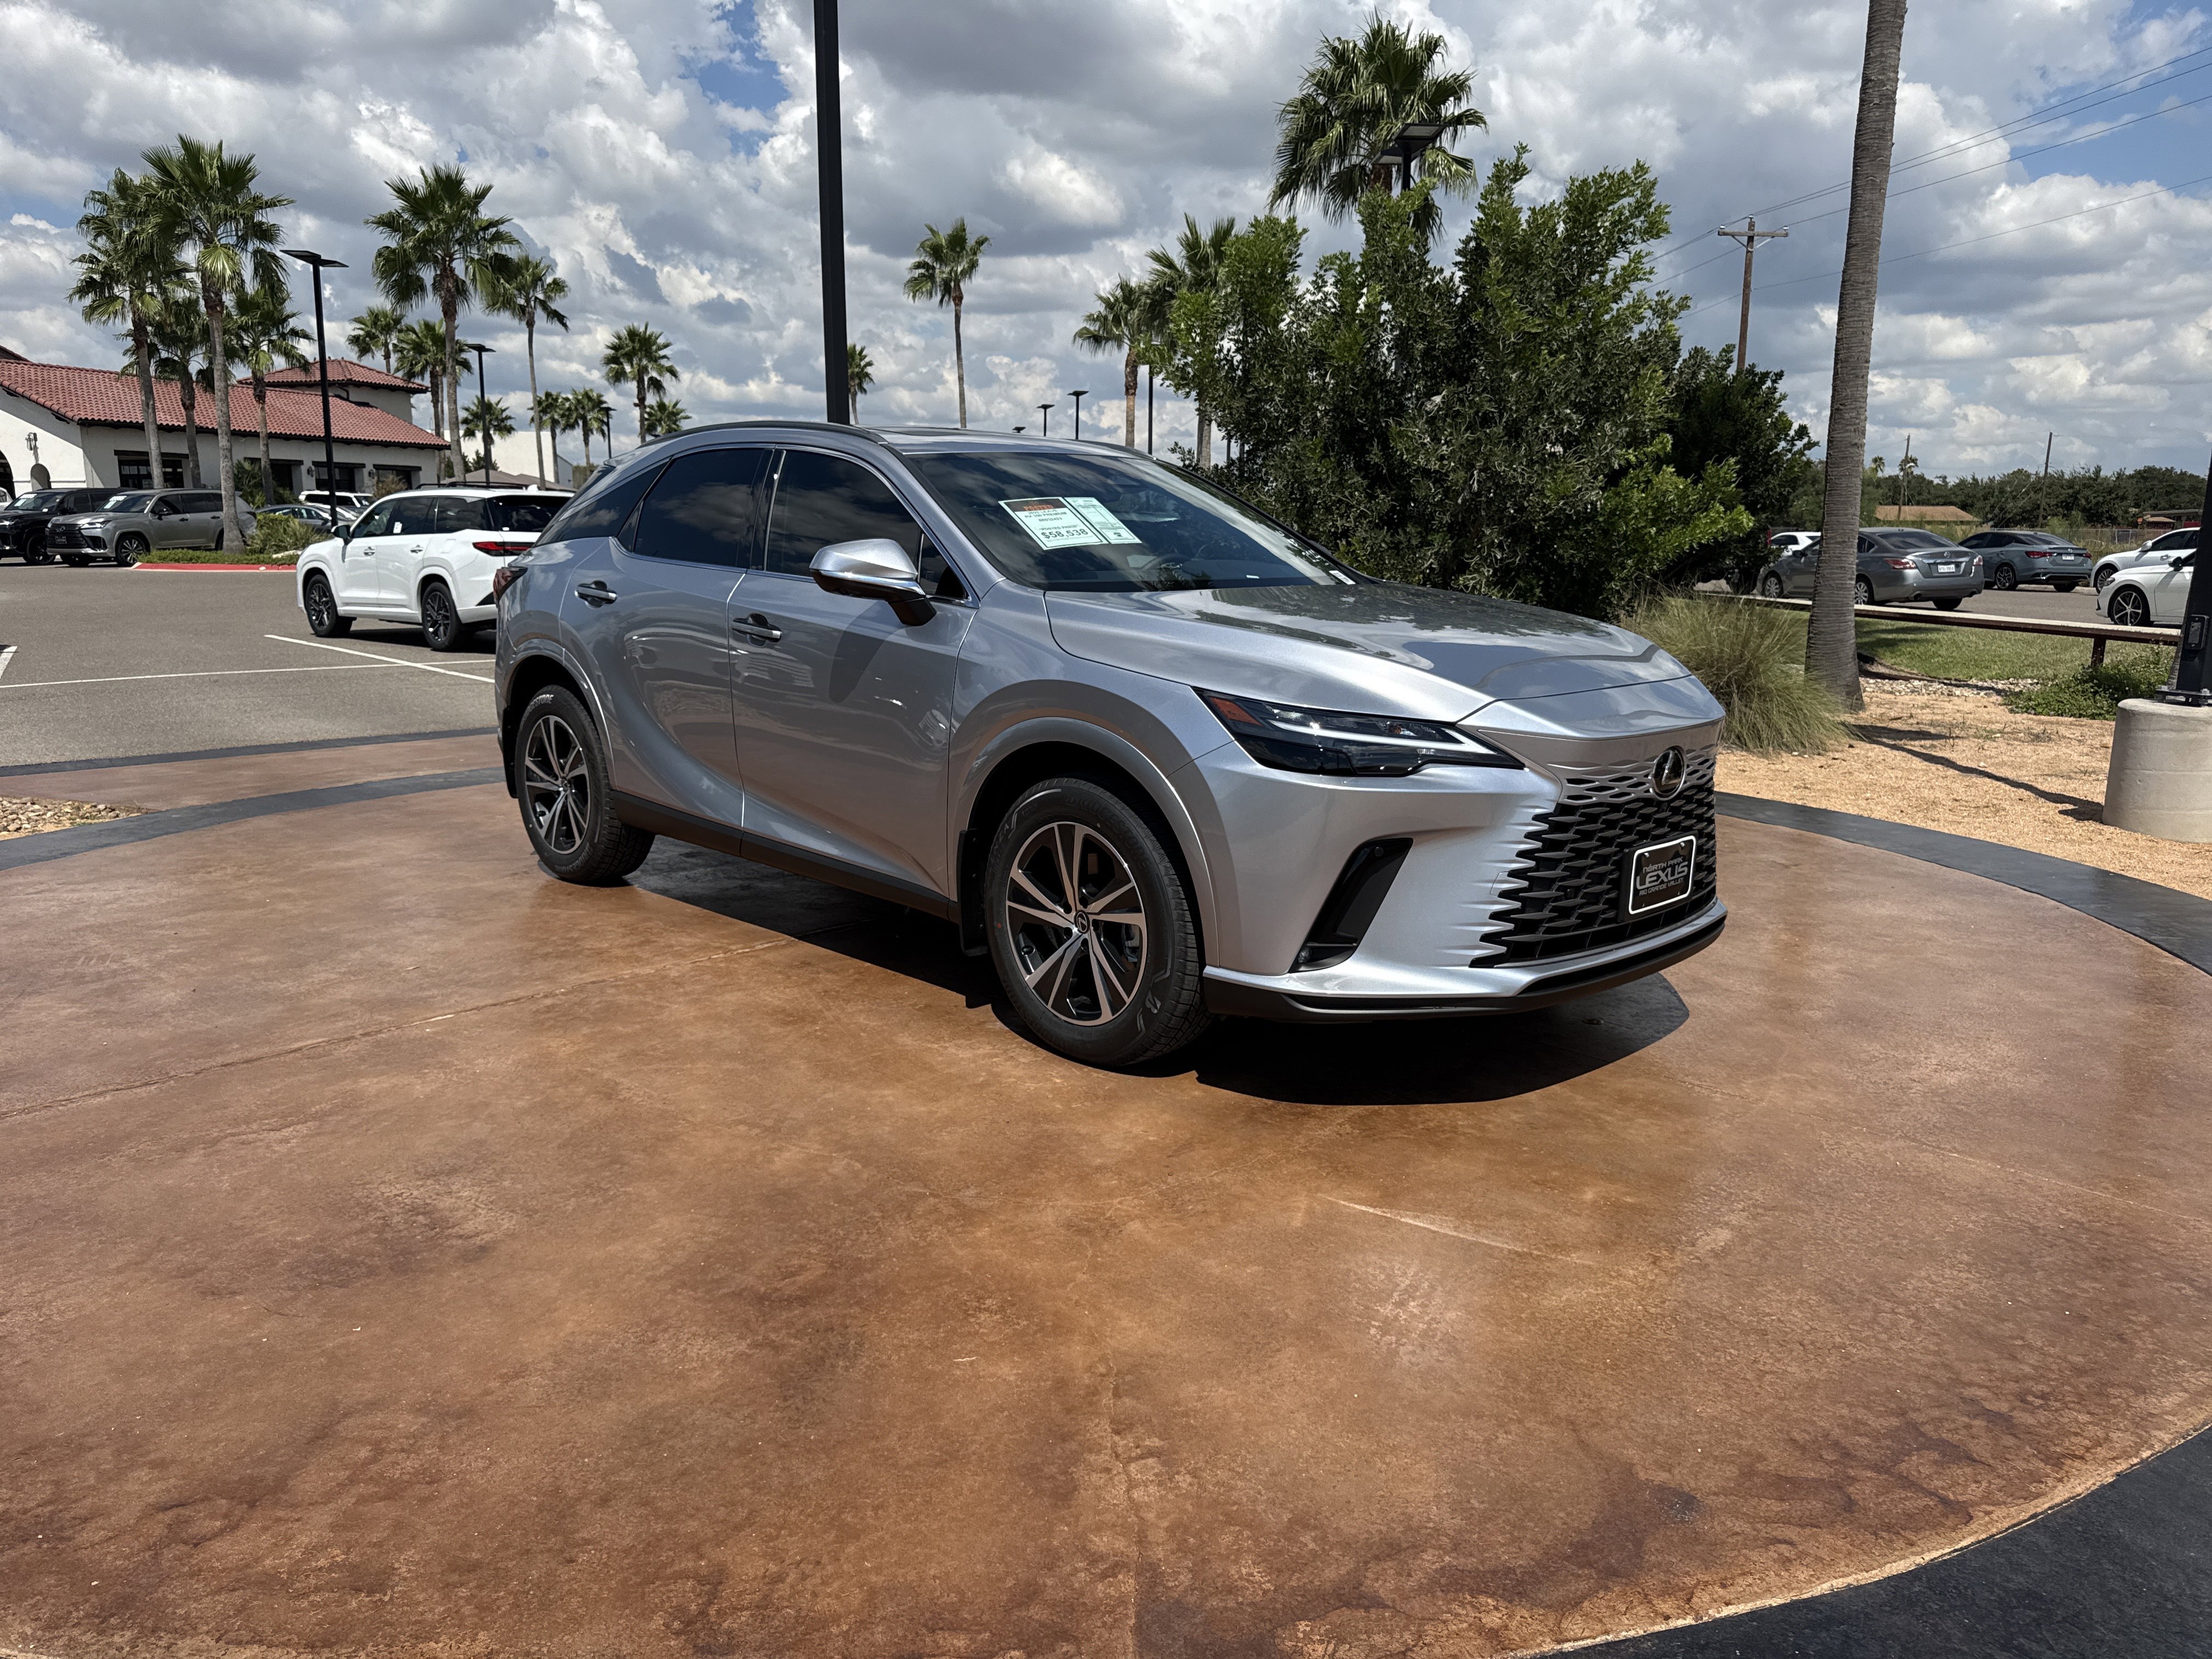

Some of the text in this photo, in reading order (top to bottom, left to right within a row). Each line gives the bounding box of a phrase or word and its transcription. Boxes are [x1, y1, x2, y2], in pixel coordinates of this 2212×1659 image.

[1041, 528, 1088, 539] $58,538
[1643, 856, 1683, 873] NORTH PARK
[1637, 861, 1688, 889] LEXUS
[1648, 883, 1667, 894] GRANDE
[1668, 877, 1684, 887] VALLEY
